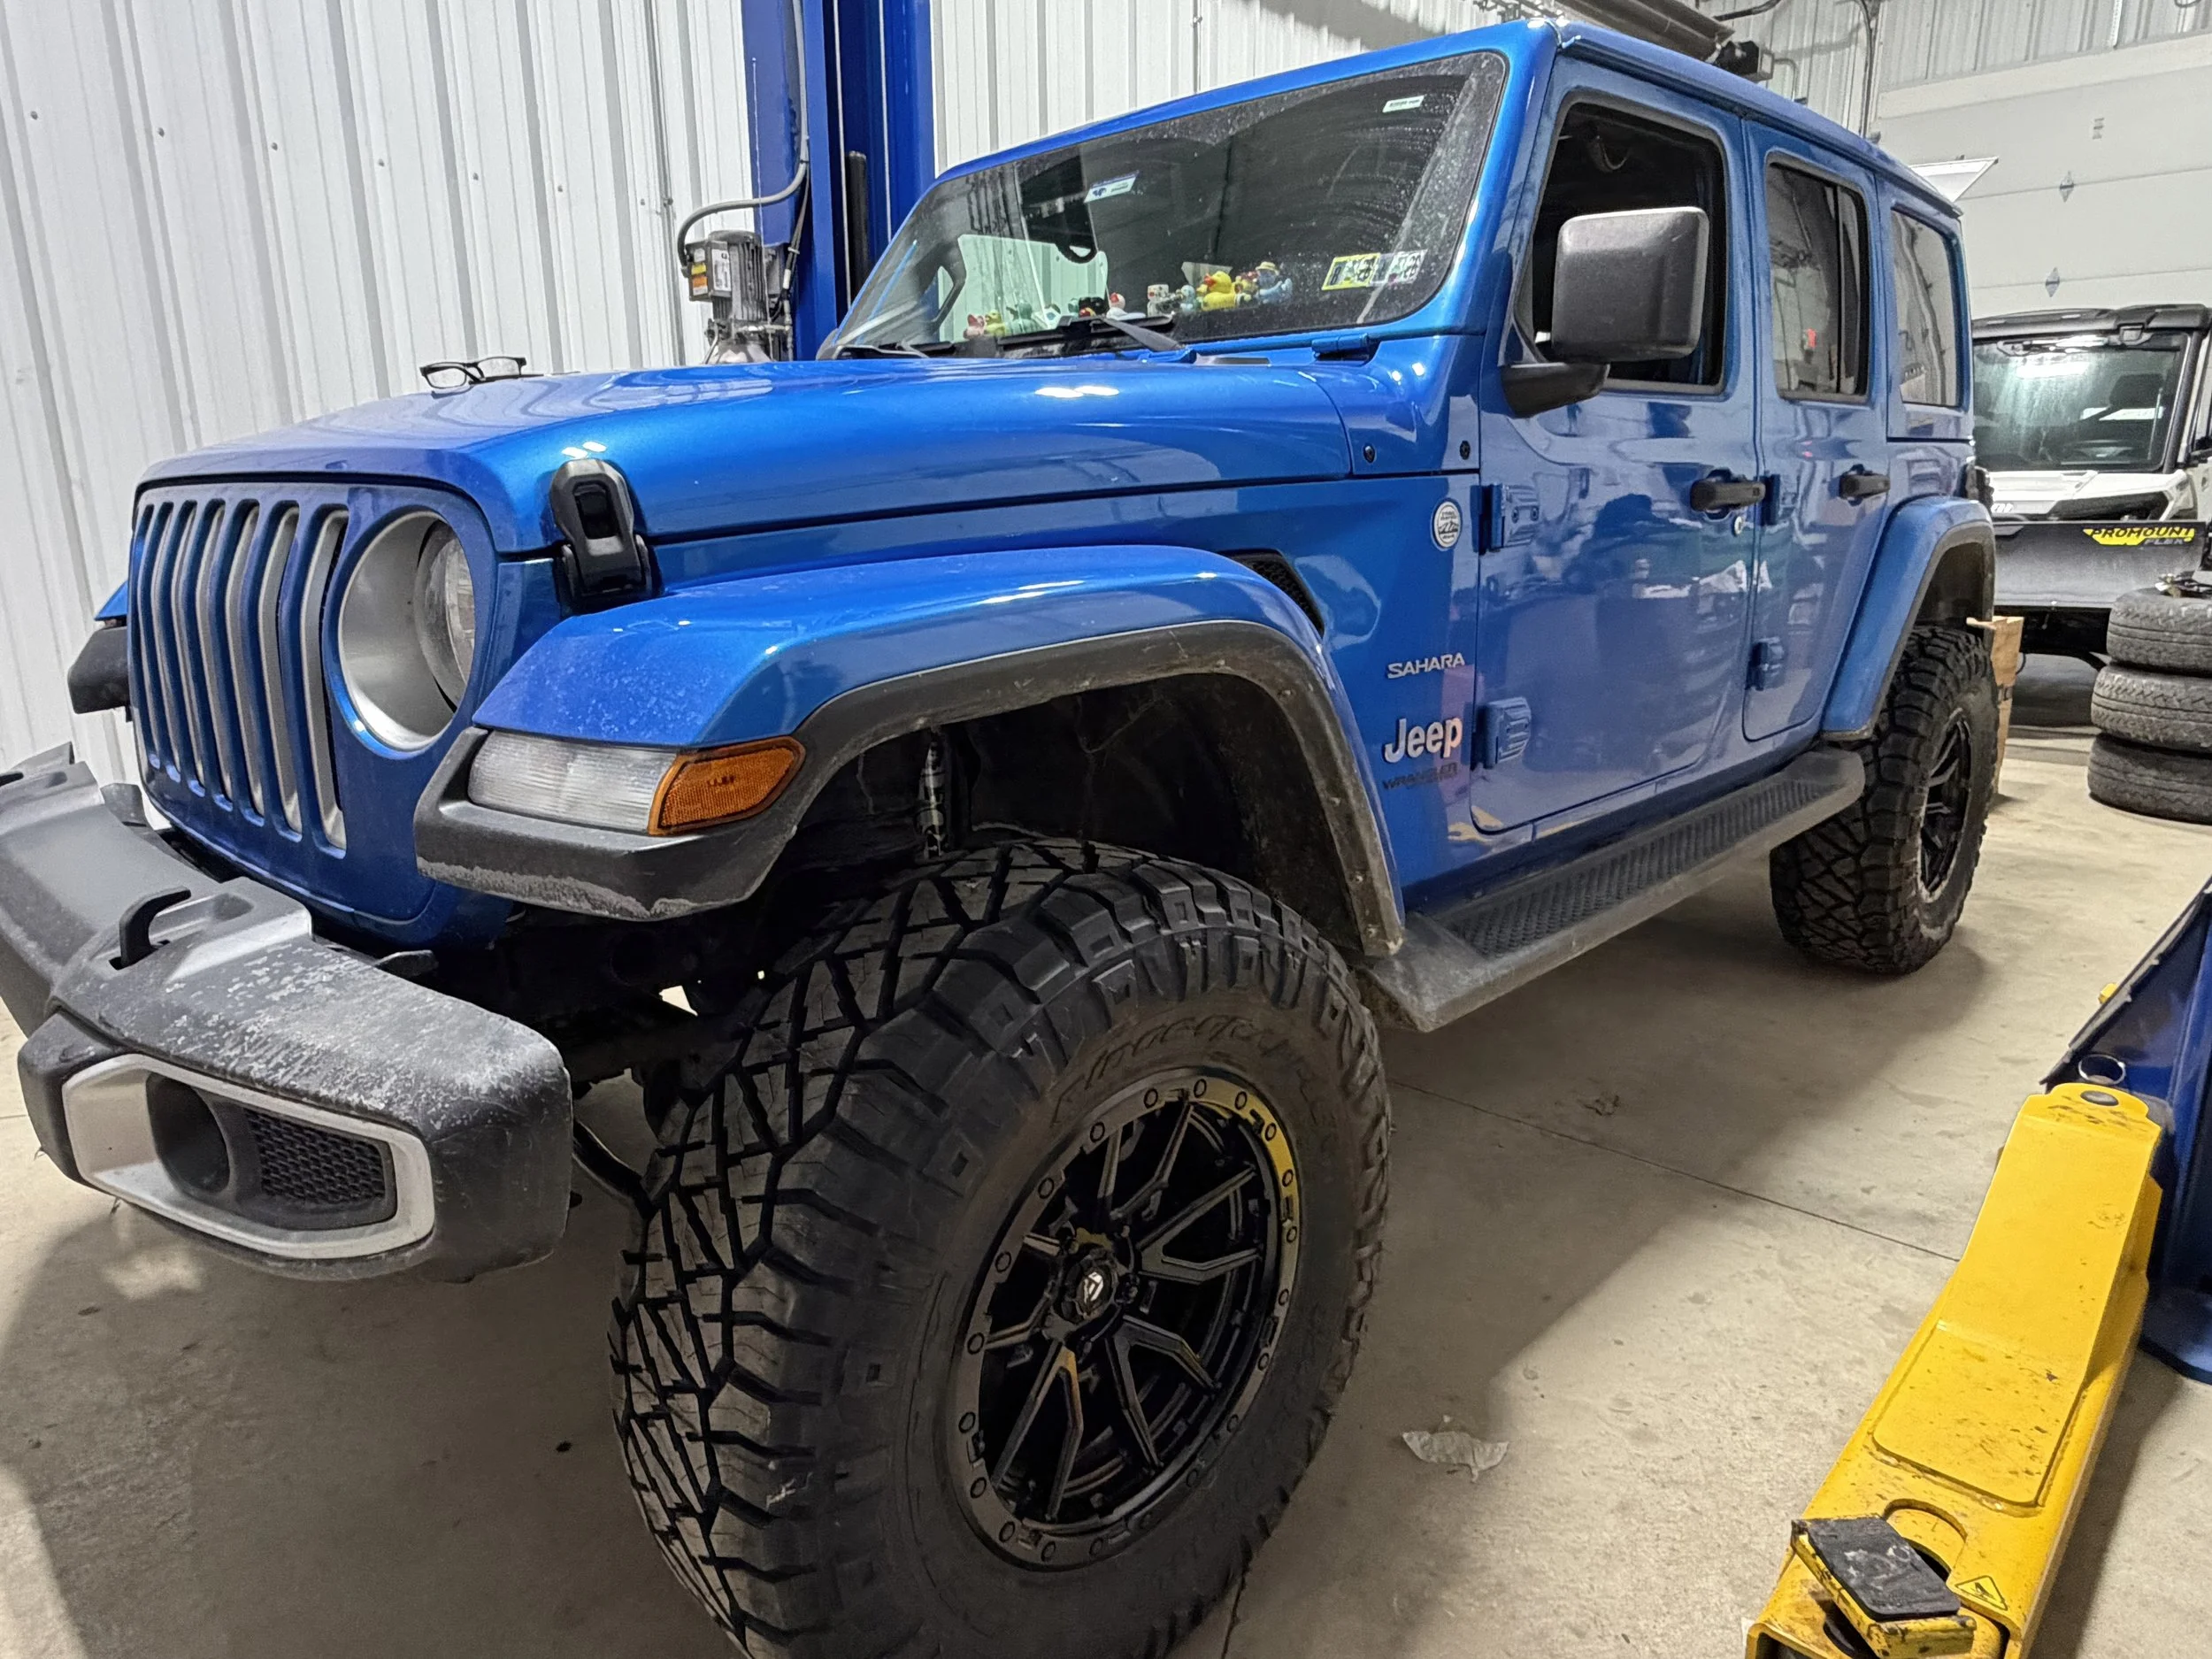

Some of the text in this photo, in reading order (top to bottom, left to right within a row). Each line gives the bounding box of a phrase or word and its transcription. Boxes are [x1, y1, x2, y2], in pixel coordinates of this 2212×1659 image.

[2091, 526, 2193, 538] PROMOUNT
[1387, 652, 1465, 679] SAHARA
[1385, 718, 1463, 764] Jeep
